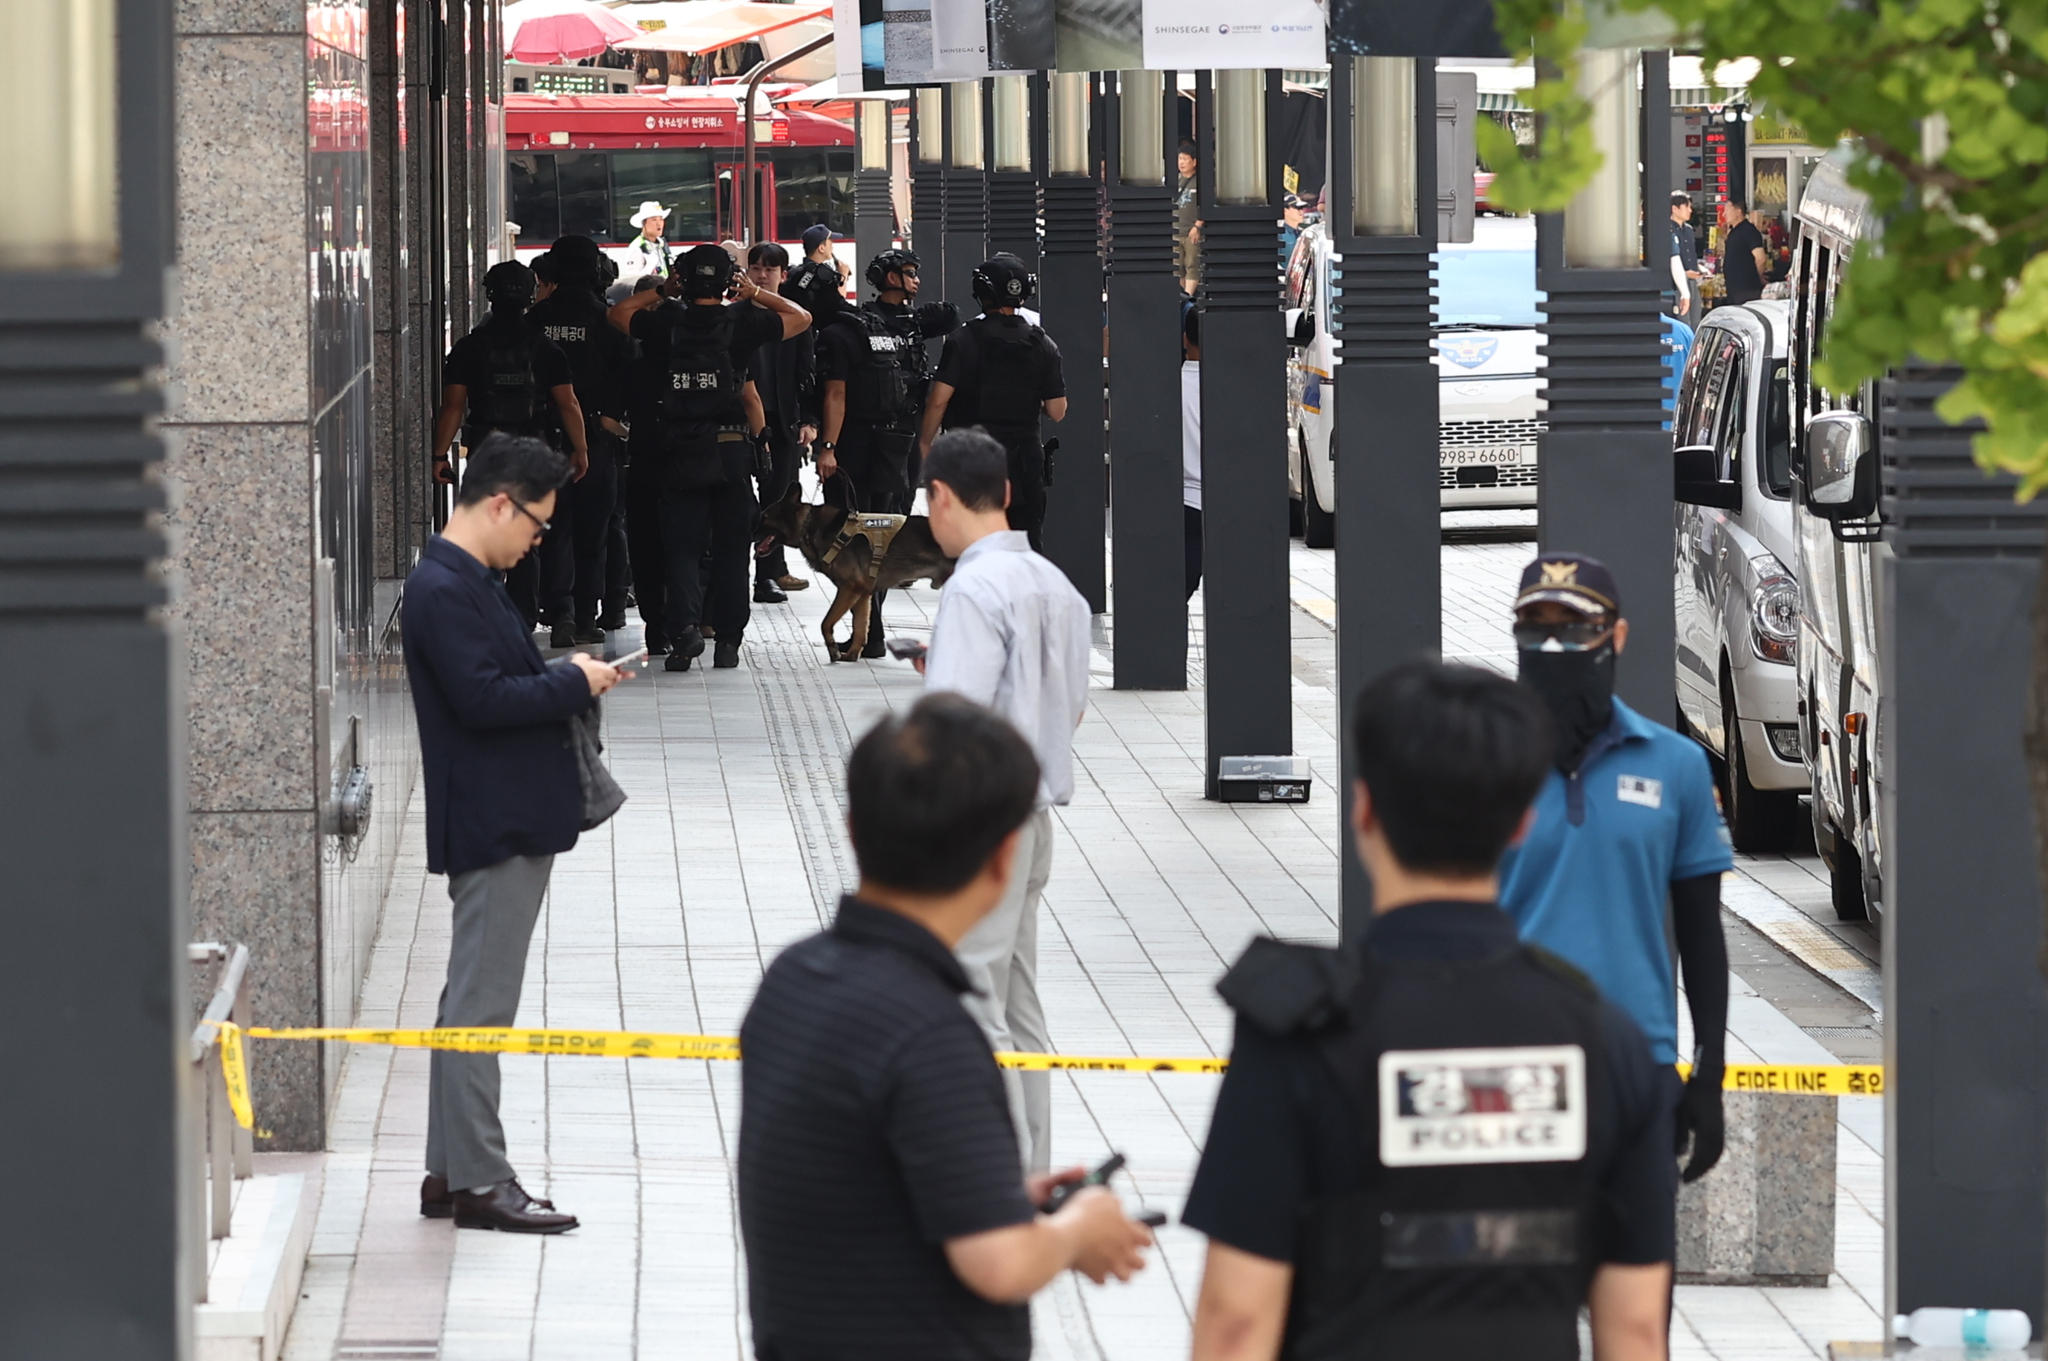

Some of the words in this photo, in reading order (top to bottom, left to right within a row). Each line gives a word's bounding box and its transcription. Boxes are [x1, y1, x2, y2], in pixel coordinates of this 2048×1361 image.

[1154, 26, 1210, 34] SHINSEGAE
[691, 116, 724, 128] 현장지휘소
[543, 325, 586, 341] 경찰특공대
[672, 372, 718, 389] 경찰공대
[1479, 448, 1516, 463] 6660
[1410, 1124, 1556, 1149] POLICE
